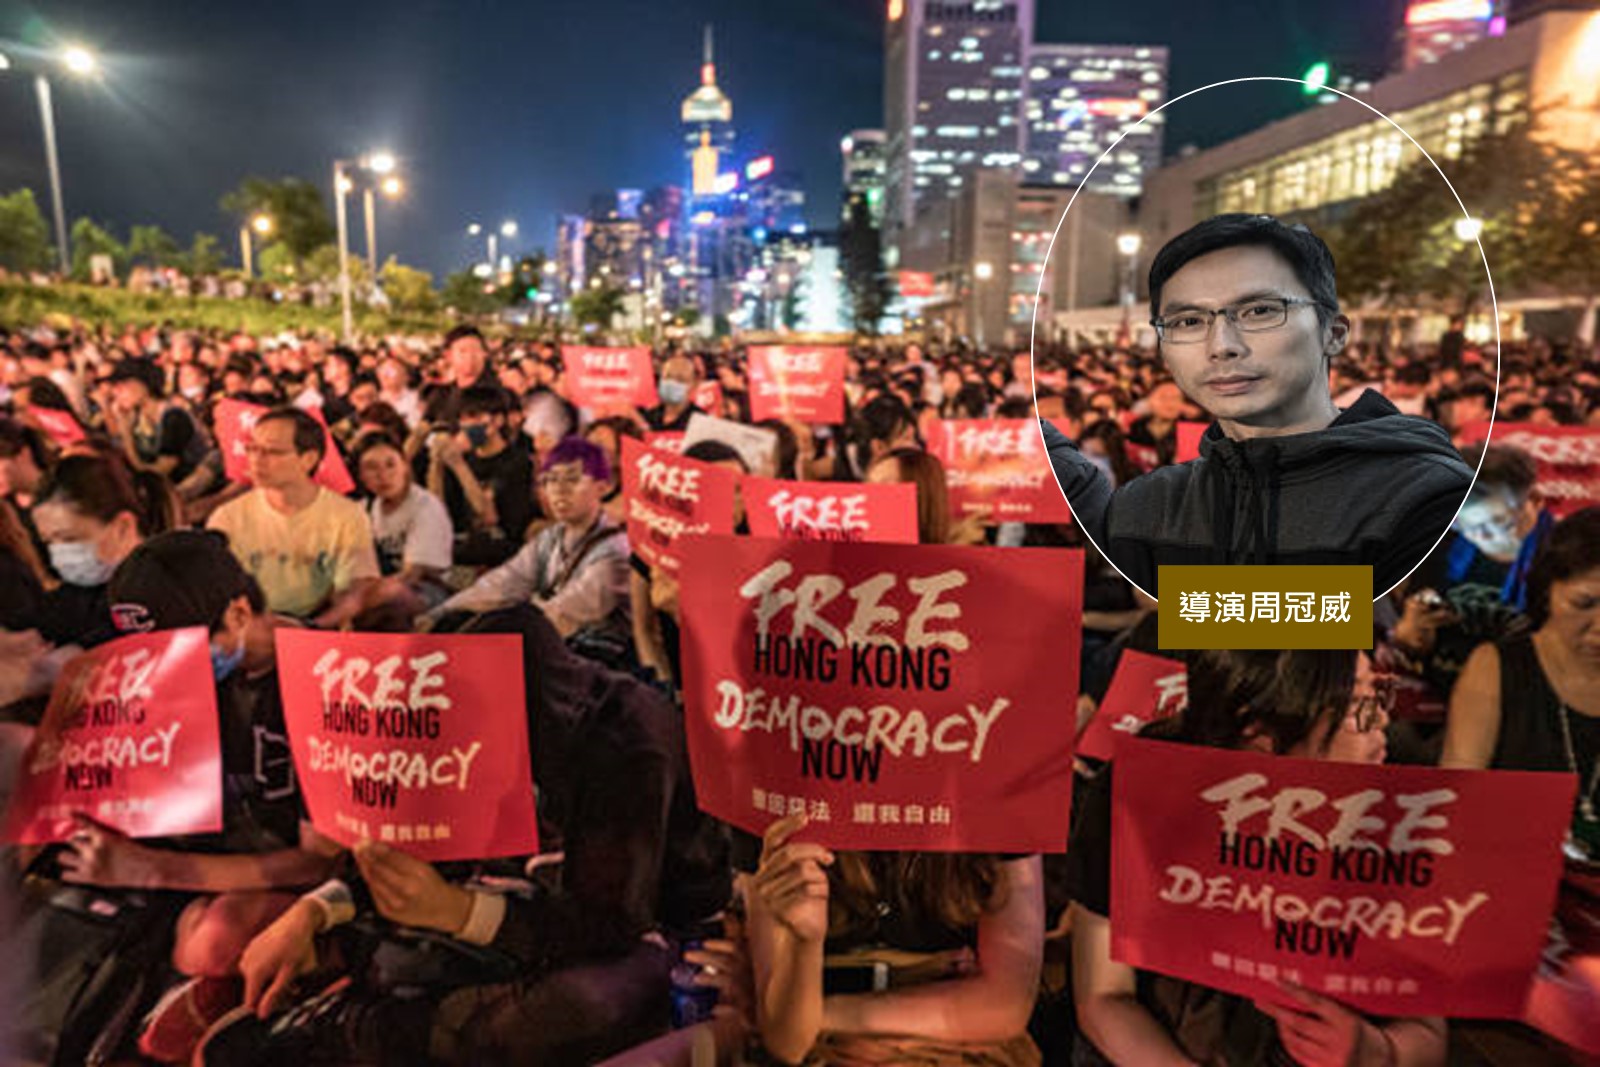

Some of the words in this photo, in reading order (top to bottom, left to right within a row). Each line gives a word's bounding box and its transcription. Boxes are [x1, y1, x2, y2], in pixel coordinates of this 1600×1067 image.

[635, 453, 702, 502] FREE
[767, 490, 870, 531] FREE
[739, 559, 969, 652] FREE
[312, 649, 452, 712] FREE
[753, 634, 838, 684] HONG
[851, 643, 951, 691] KONG
[323, 703, 369, 737] HONG
[376, 705, 441, 740] KONG
[714, 680, 1010, 762] DEMOCRACY
[307, 736, 481, 790] DEMOCRACY
[802, 735, 882, 783] NOW
[352, 777, 399, 810] NOW
[1200, 773, 1457, 855] FREE
[1218, 830, 1318, 877] HONG
[1329, 843, 1434, 887] KONG
[1160, 865, 1489, 945] DEMOCRACY
[1274, 918, 1359, 959] NOW
